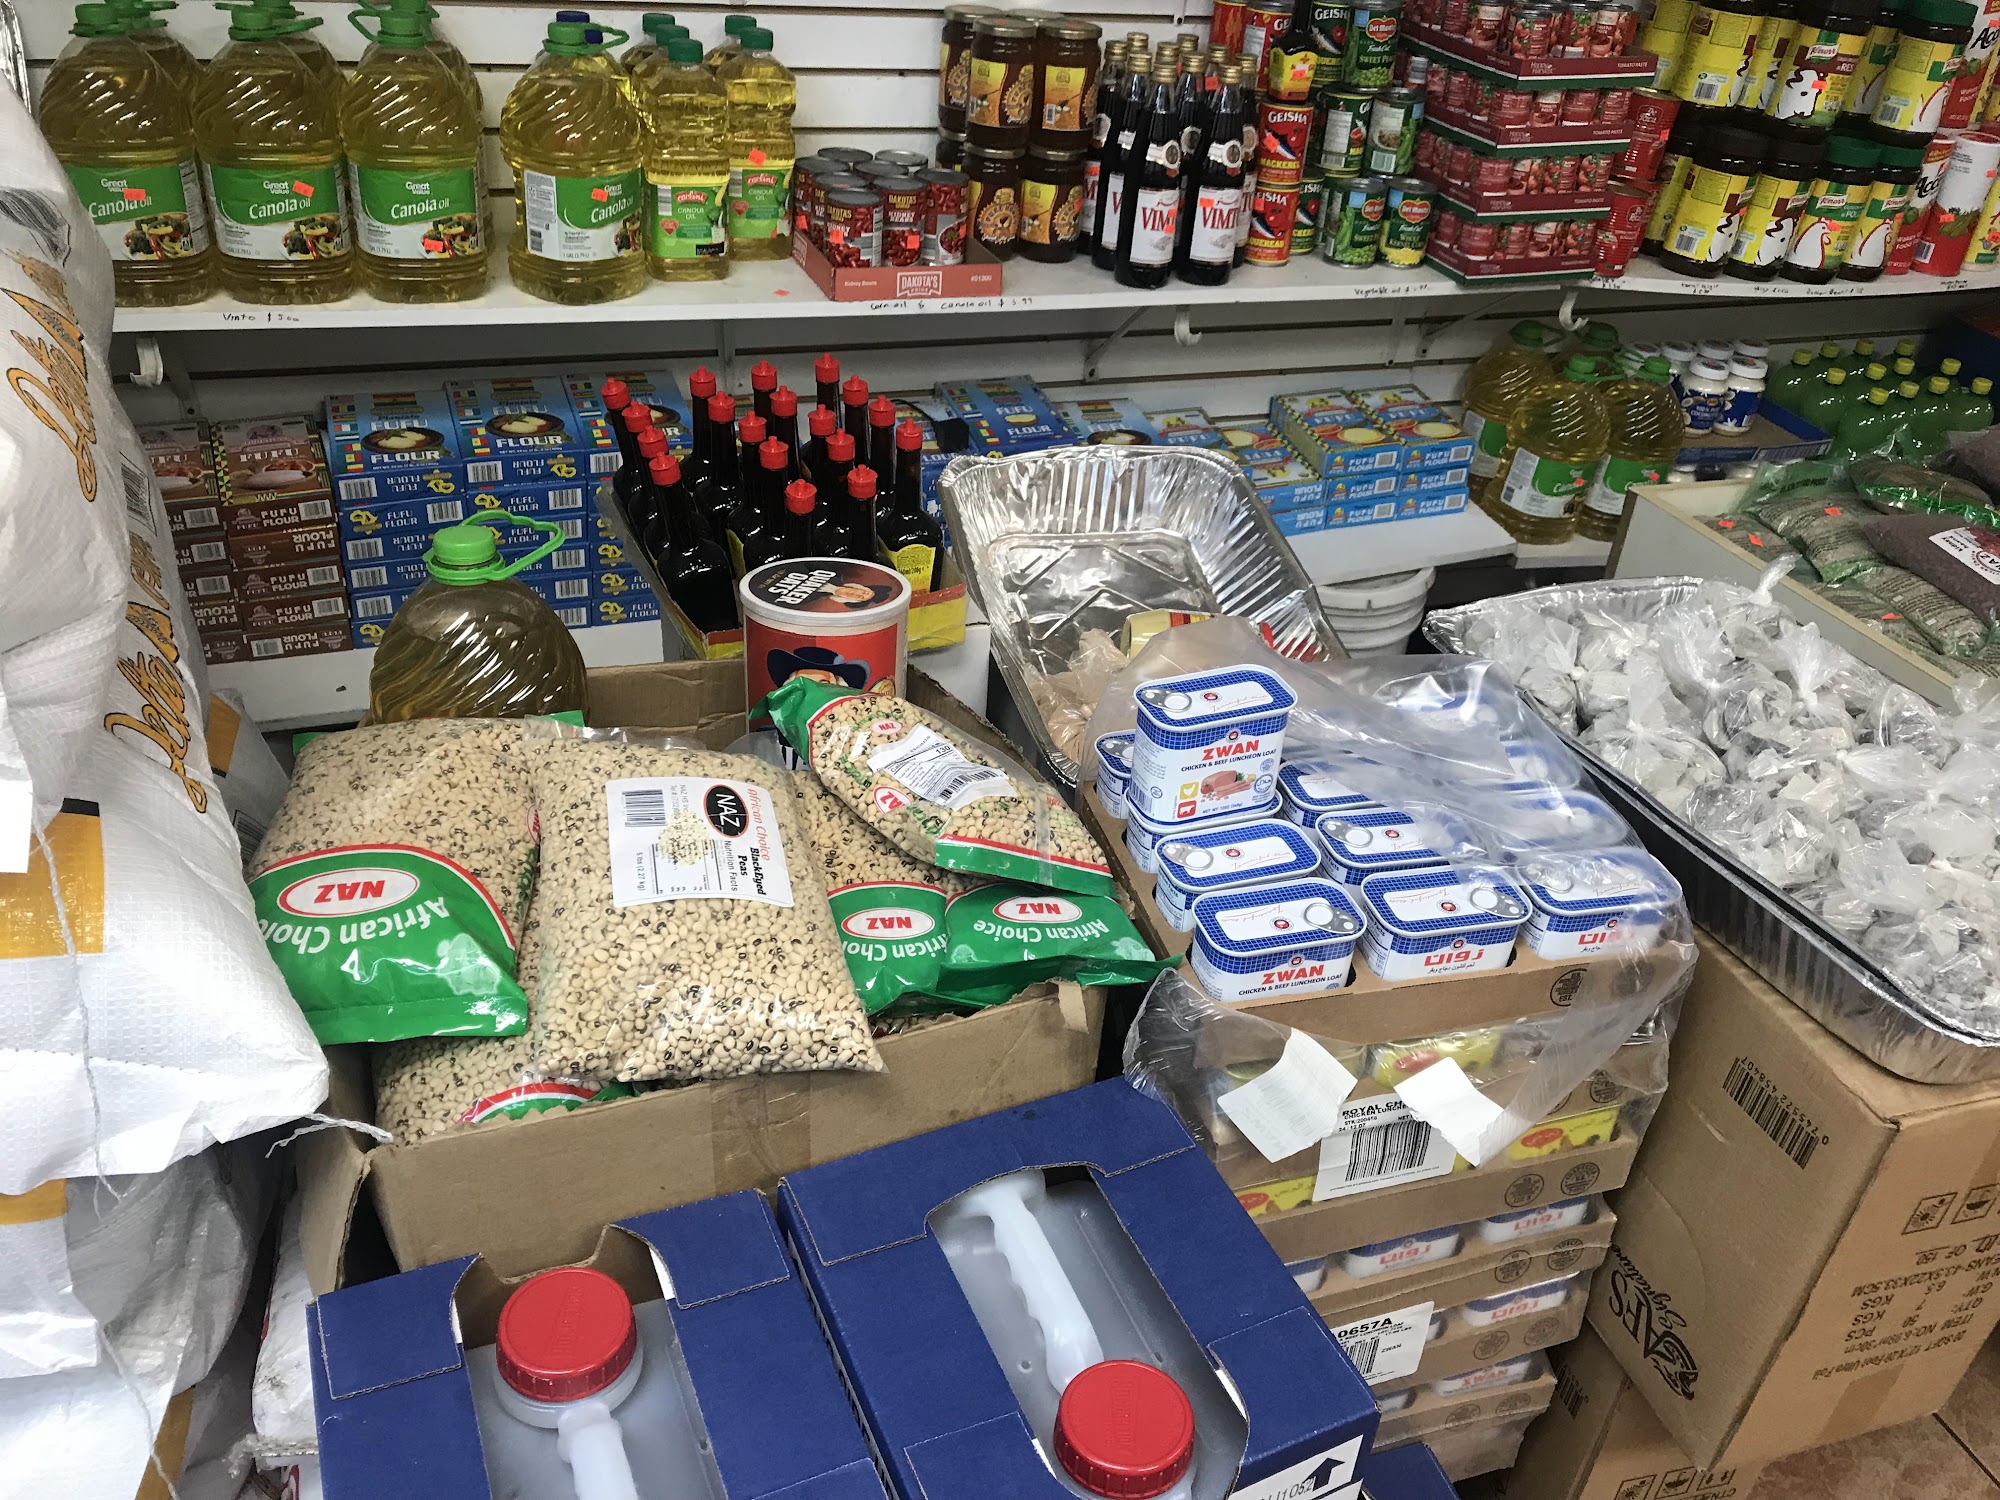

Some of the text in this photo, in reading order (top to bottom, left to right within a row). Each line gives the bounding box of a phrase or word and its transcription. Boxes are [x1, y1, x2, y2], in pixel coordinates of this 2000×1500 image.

[263, 181, 289, 191] Great
[406, 181, 430, 191] Great
[89, 198, 138, 218] Canola
[249, 197, 311, 219] Canola oil
[391, 197, 450, 219] Canola oil
[590, 199, 626, 223] Canola
[1202, 206, 1240, 229] VIMT
[901, 274, 938, 289] DAKOTA'S
[1007, 425, 1052, 436] FLOUR
[496, 435, 563, 448] FLOUR
[370, 450, 441, 463] FLOUR
[508, 503, 540, 512] FLOUR
[510, 496, 536, 505] FUFU
[263, 515, 299, 527] FLOUR
[385, 516, 418, 527] FLOUR
[387, 509, 414, 520] FUFU
[292, 530, 334, 543] FLOUR
[272, 581, 308, 592] FLOUR
[768, 571, 809, 596] OATS
[774, 569, 837, 606] QUAKER
[278, 612, 313, 623] FLOUR
[935, 746, 951, 755] 130
[1201, 739, 1260, 761] ZWAN
[1181, 762, 1207, 772] CHICKEN
[1214, 758, 1228, 766] BEEF
[1229, 753, 1261, 764] LUNCHEON
[715, 793, 741, 828] NAZ
[746, 789, 771, 861] African Choice
[724, 840, 738, 892] Nutrition Facts
[737, 855, 749, 876] Peas
[750, 848, 767, 896] BlackEyed
[313, 880, 386, 903] NAZ
[1016, 903, 1063, 915] NAZ
[340, 897, 450, 944] African
[866, 917, 912, 929] NAZ
[973, 918, 1110, 943] African Choice
[892, 932, 948, 959] frican
[1424, 949, 1484, 966] زوان
[1262, 965, 1324, 985] ZWAN
[1238, 987, 1267, 996] CHICKEN
[1274, 982, 1290, 991] BEEF
[1291, 977, 1326, 988] LUNCHEON
[1327, 973, 1343, 982] LOAF
[1342, 1104, 1381, 1117] ROYAL
[1944, 1244, 1967, 1259] OF
[1860, 1294, 1894, 1310] KGS
[1851, 1309, 1885, 1326] KGS
[1901, 1314, 1919, 1328] 50
[1844, 1326, 1876, 1342] PCS
